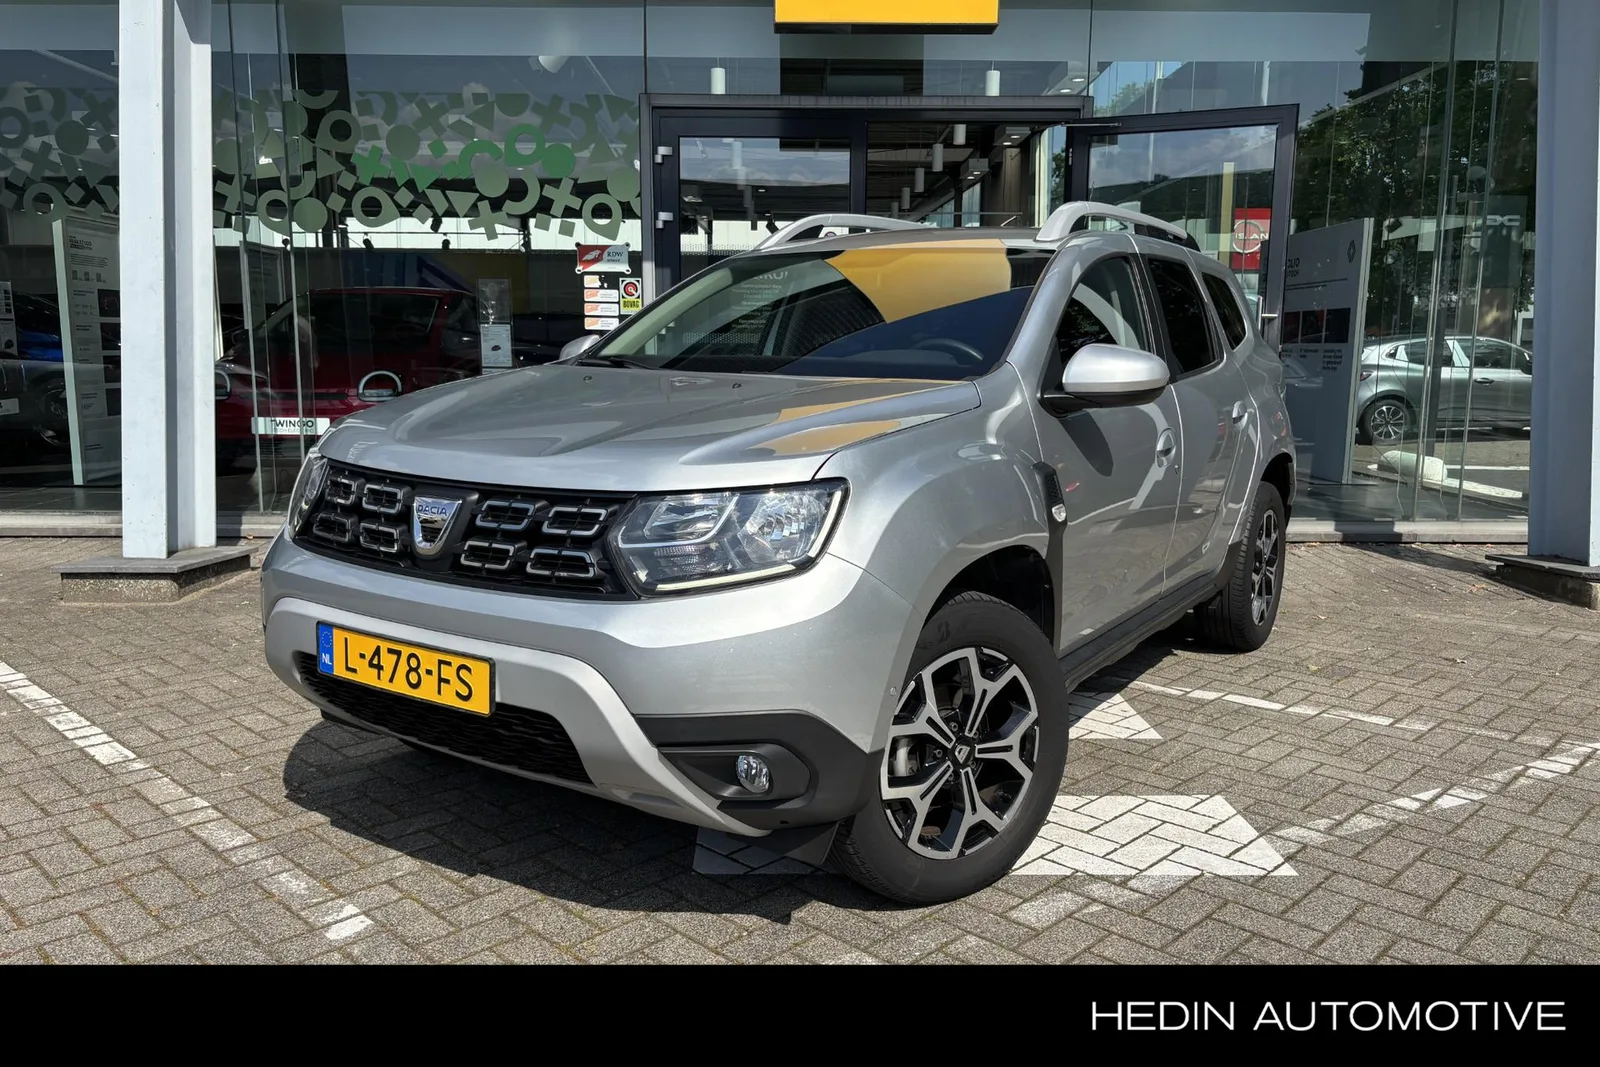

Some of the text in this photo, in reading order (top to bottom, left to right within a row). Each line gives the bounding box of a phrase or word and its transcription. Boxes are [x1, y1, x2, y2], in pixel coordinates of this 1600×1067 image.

[623, 300, 640, 309] BOVAG
[417, 504, 447, 516] DACIA
[321, 652, 333, 666] NL
[343, 636, 474, 702] L-478-FS
